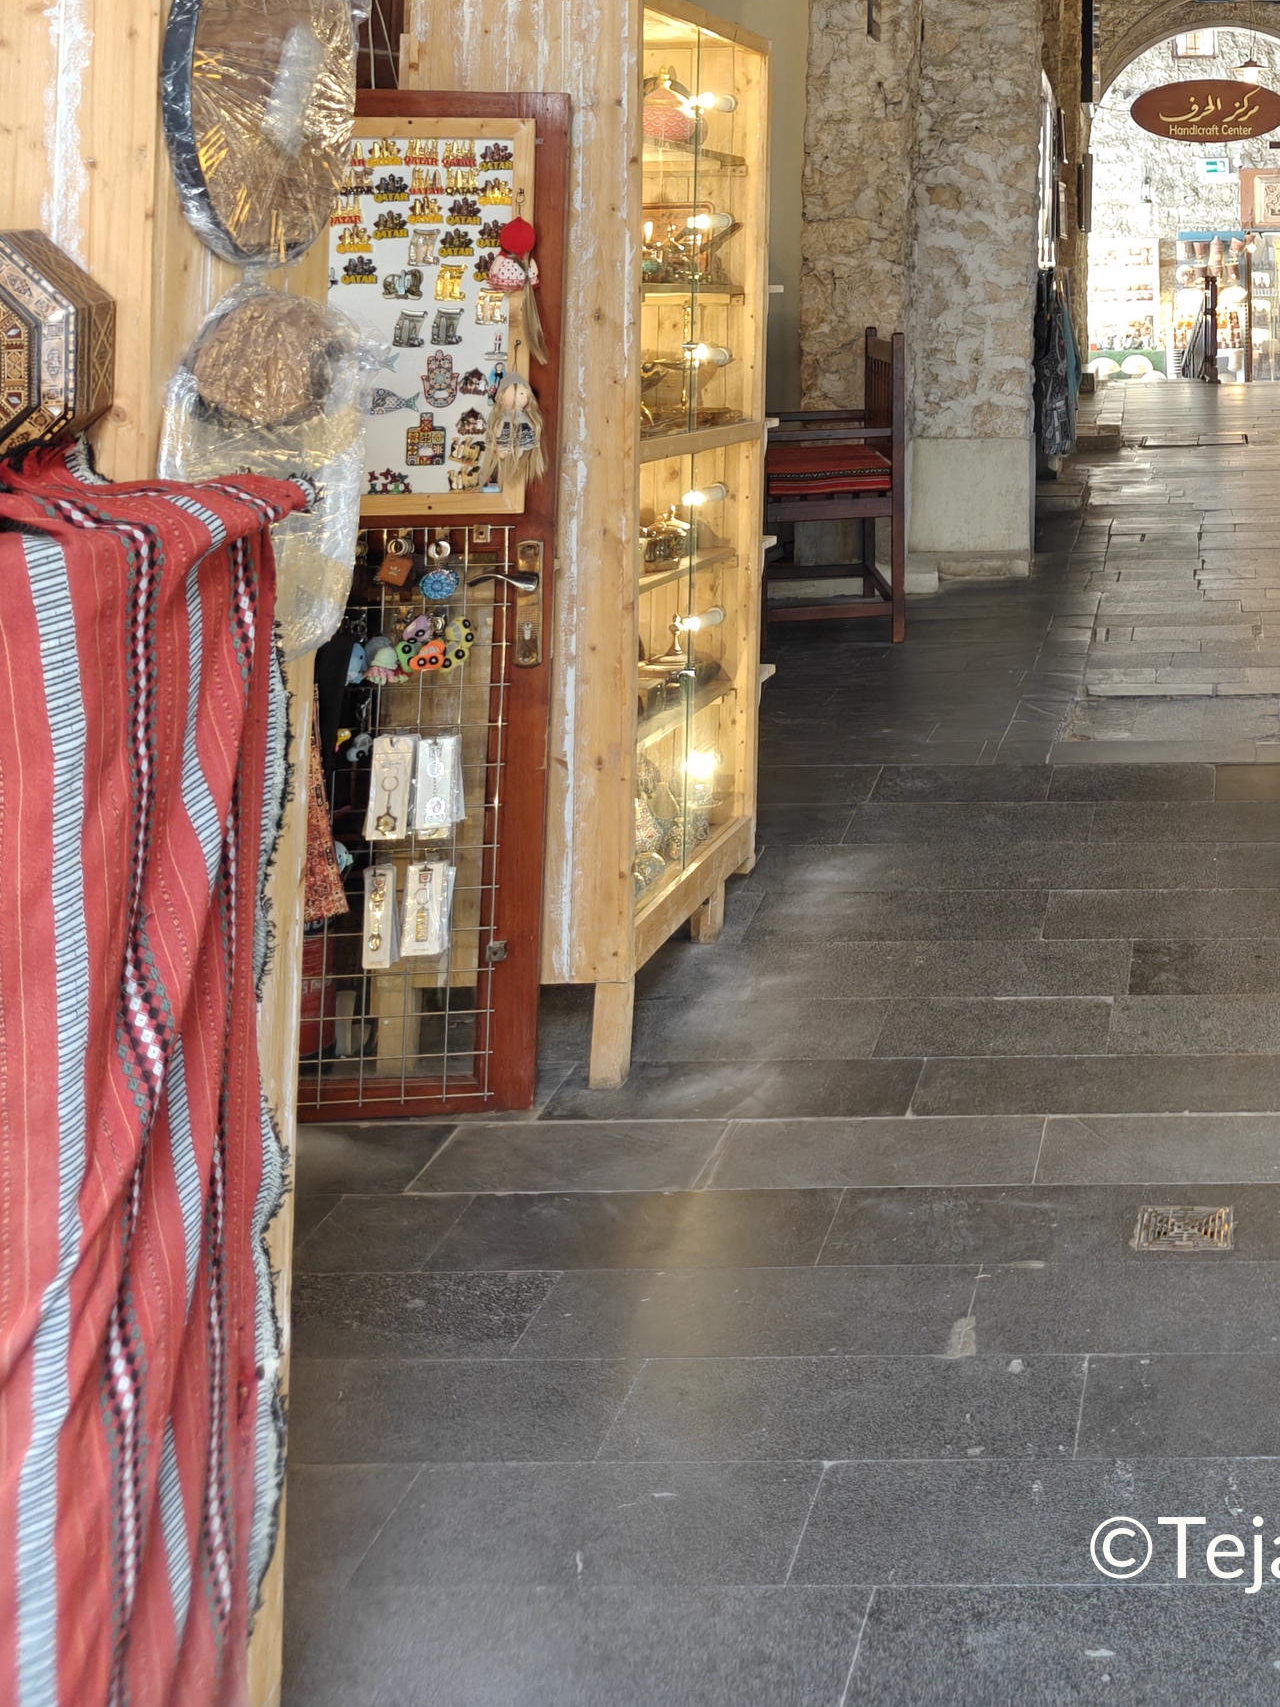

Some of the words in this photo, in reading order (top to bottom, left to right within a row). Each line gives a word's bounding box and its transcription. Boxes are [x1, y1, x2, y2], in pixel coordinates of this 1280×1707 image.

[1159, 94, 1222, 122] الحرف
[1222, 86, 1261, 122] مركز
[1169, 125, 1219, 136] Handicraft
[1221, 125, 1252, 136] Center
[404, 157, 438, 166] QATAR
[442, 158, 476, 167] QATAR
[479, 161, 513, 171] QATAR
[340, 187, 373, 196] QATAR
[445, 187, 480, 196] QATAR
[374, 194, 409, 202] QATAR
[446, 216, 481, 225] QATAR
[373, 229, 408, 239] QATAR
[476, 239, 500, 248] QATA
[438, 247, 474, 256] QATAR
[341, 274, 377, 284] QATAR
